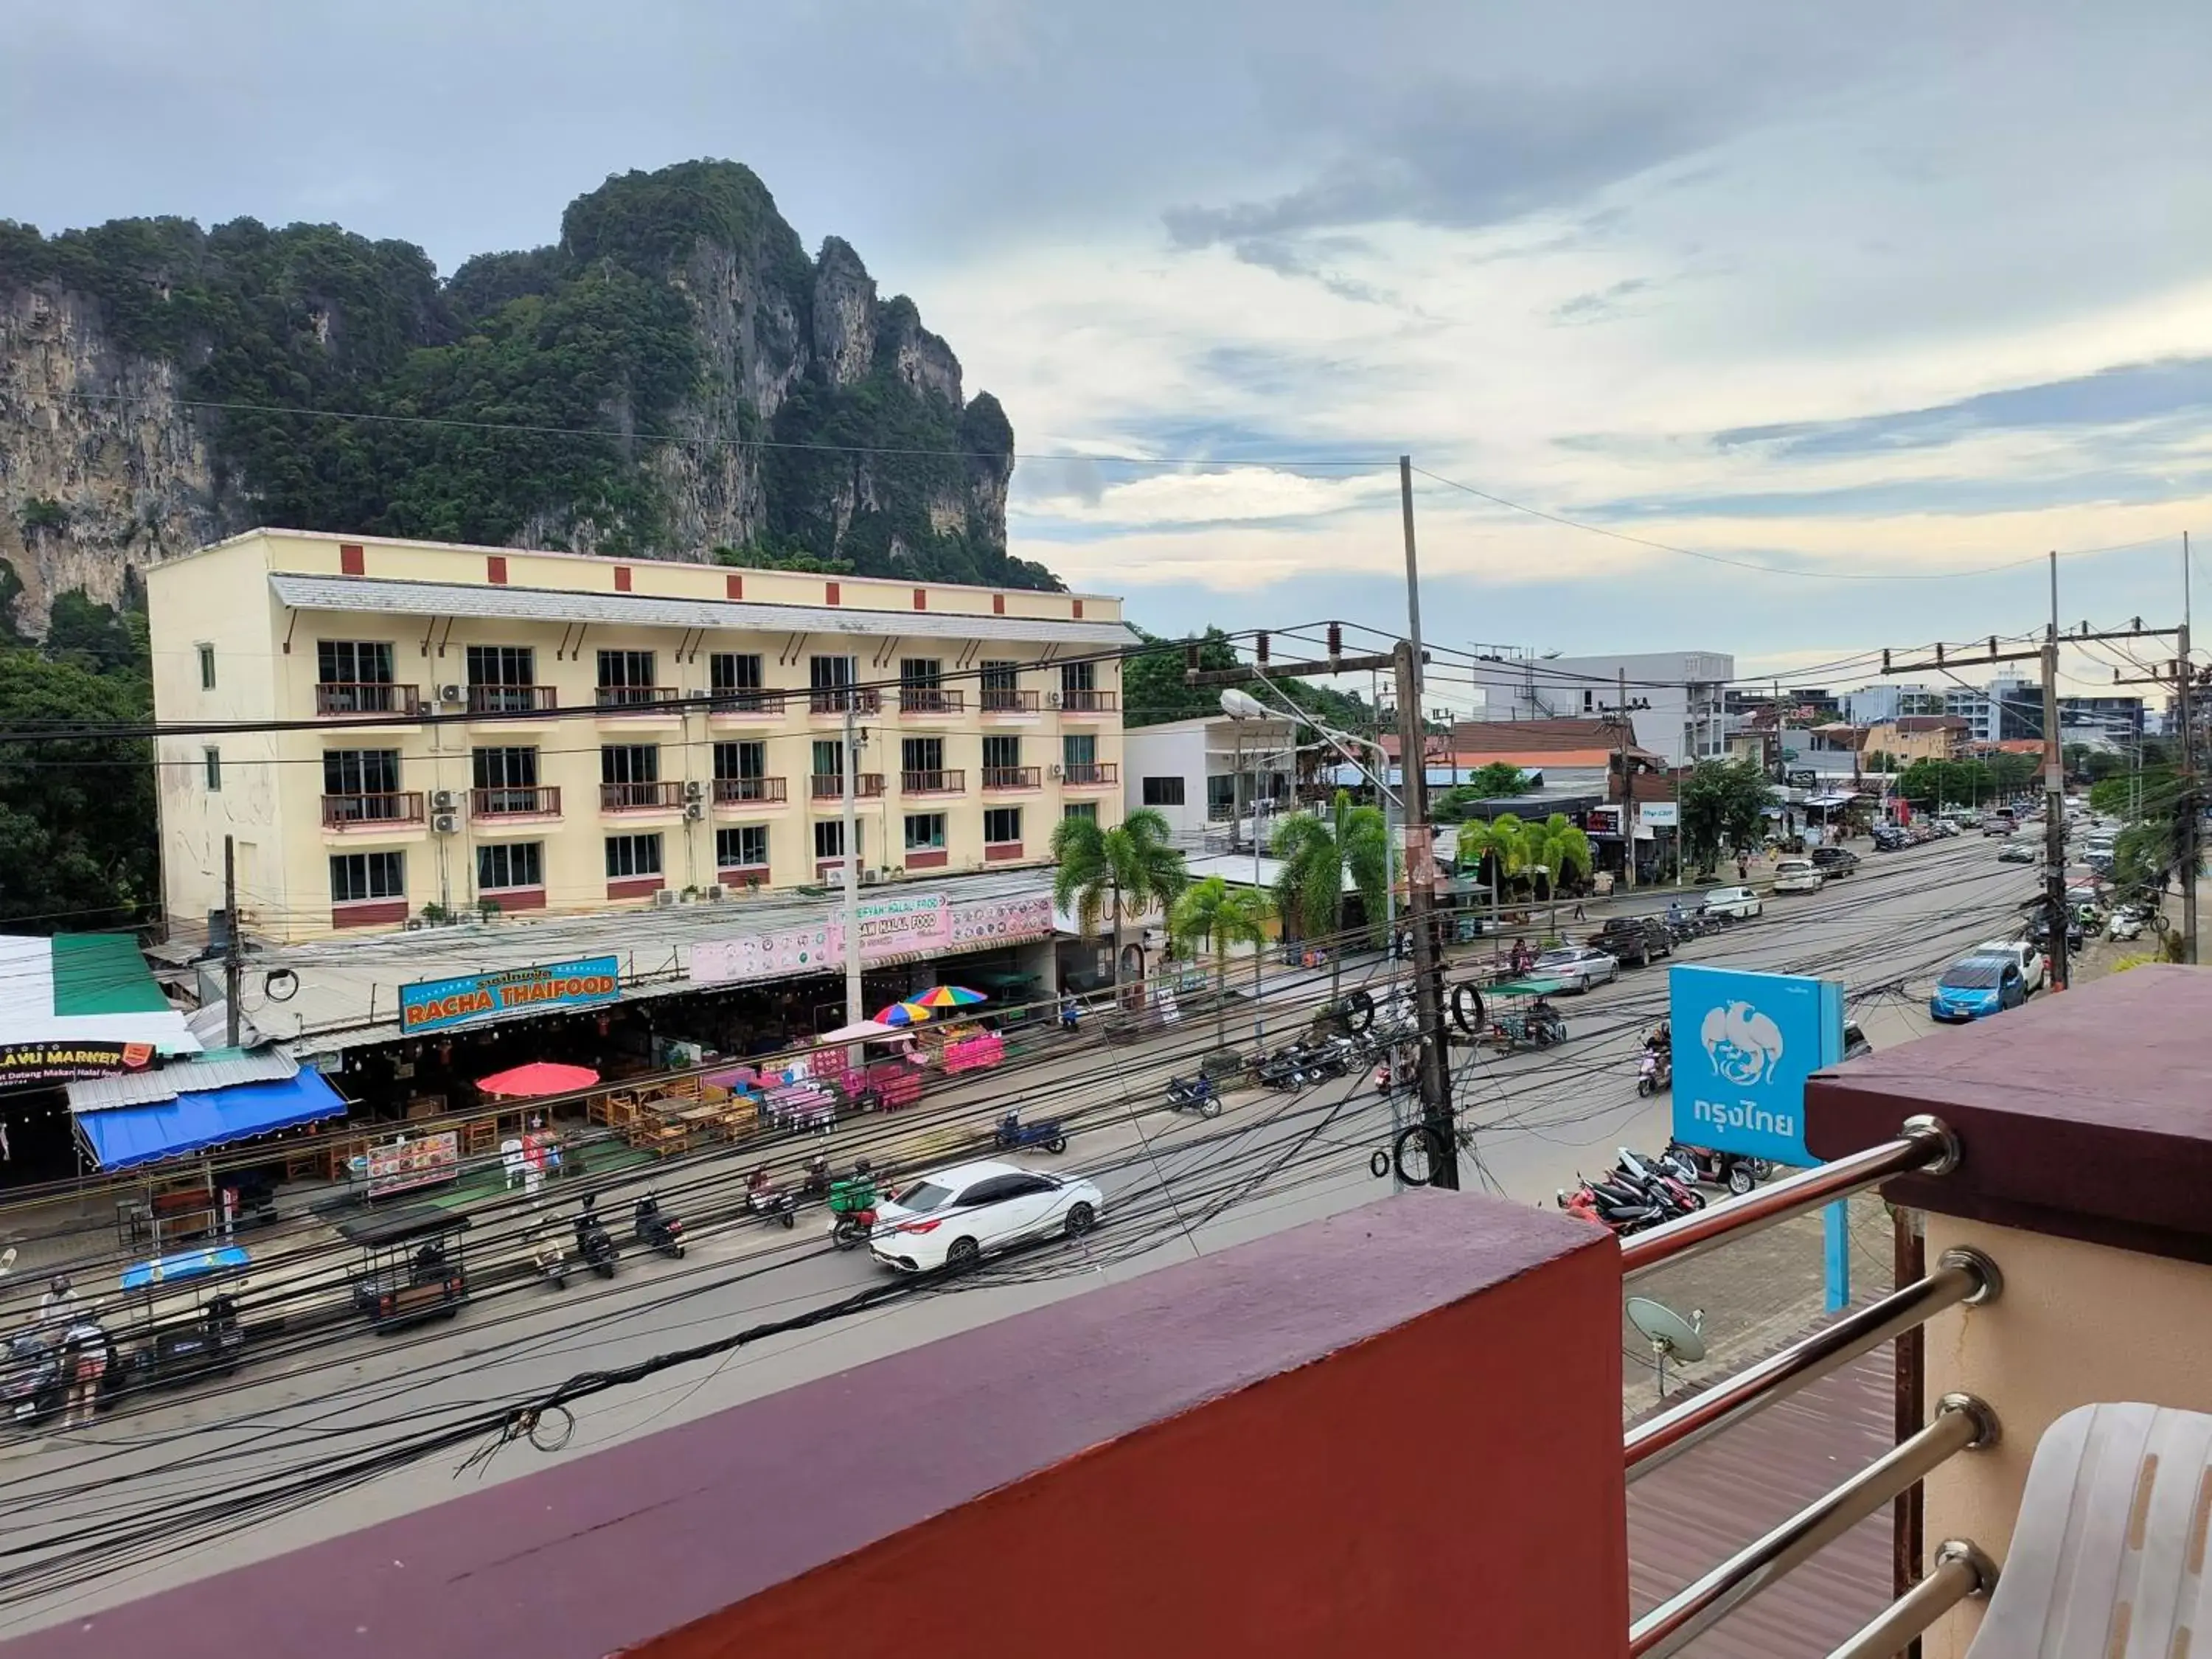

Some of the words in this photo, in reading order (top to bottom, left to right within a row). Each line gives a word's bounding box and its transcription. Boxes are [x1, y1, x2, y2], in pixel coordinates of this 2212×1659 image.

[911, 914, 937, 929] FOOD
[406, 990, 493, 1024] RACHA
[500, 976, 615, 1006] THAIFOOD
[46, 1051, 119, 1065] MARKET
[8, 1071, 42, 1079] Datang
[77, 1068, 100, 1077] Halal
[1694, 1099, 1793, 1136] กรุงไทย
